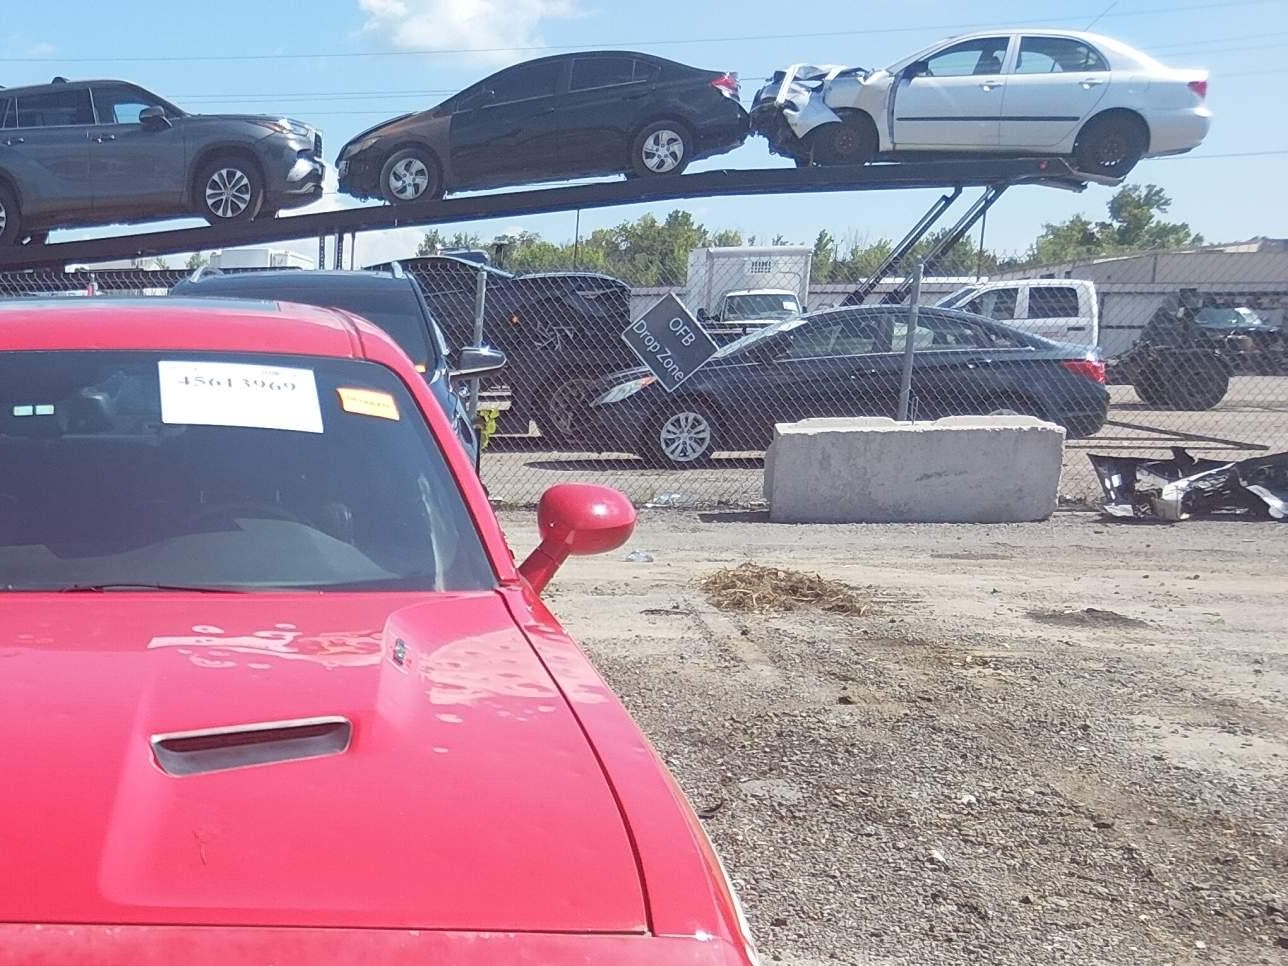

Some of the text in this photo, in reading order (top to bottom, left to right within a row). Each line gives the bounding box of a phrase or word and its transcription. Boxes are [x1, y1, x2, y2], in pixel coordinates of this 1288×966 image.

[632, 319, 685, 381] Drop Zone
[669, 317, 696, 347] OFB
